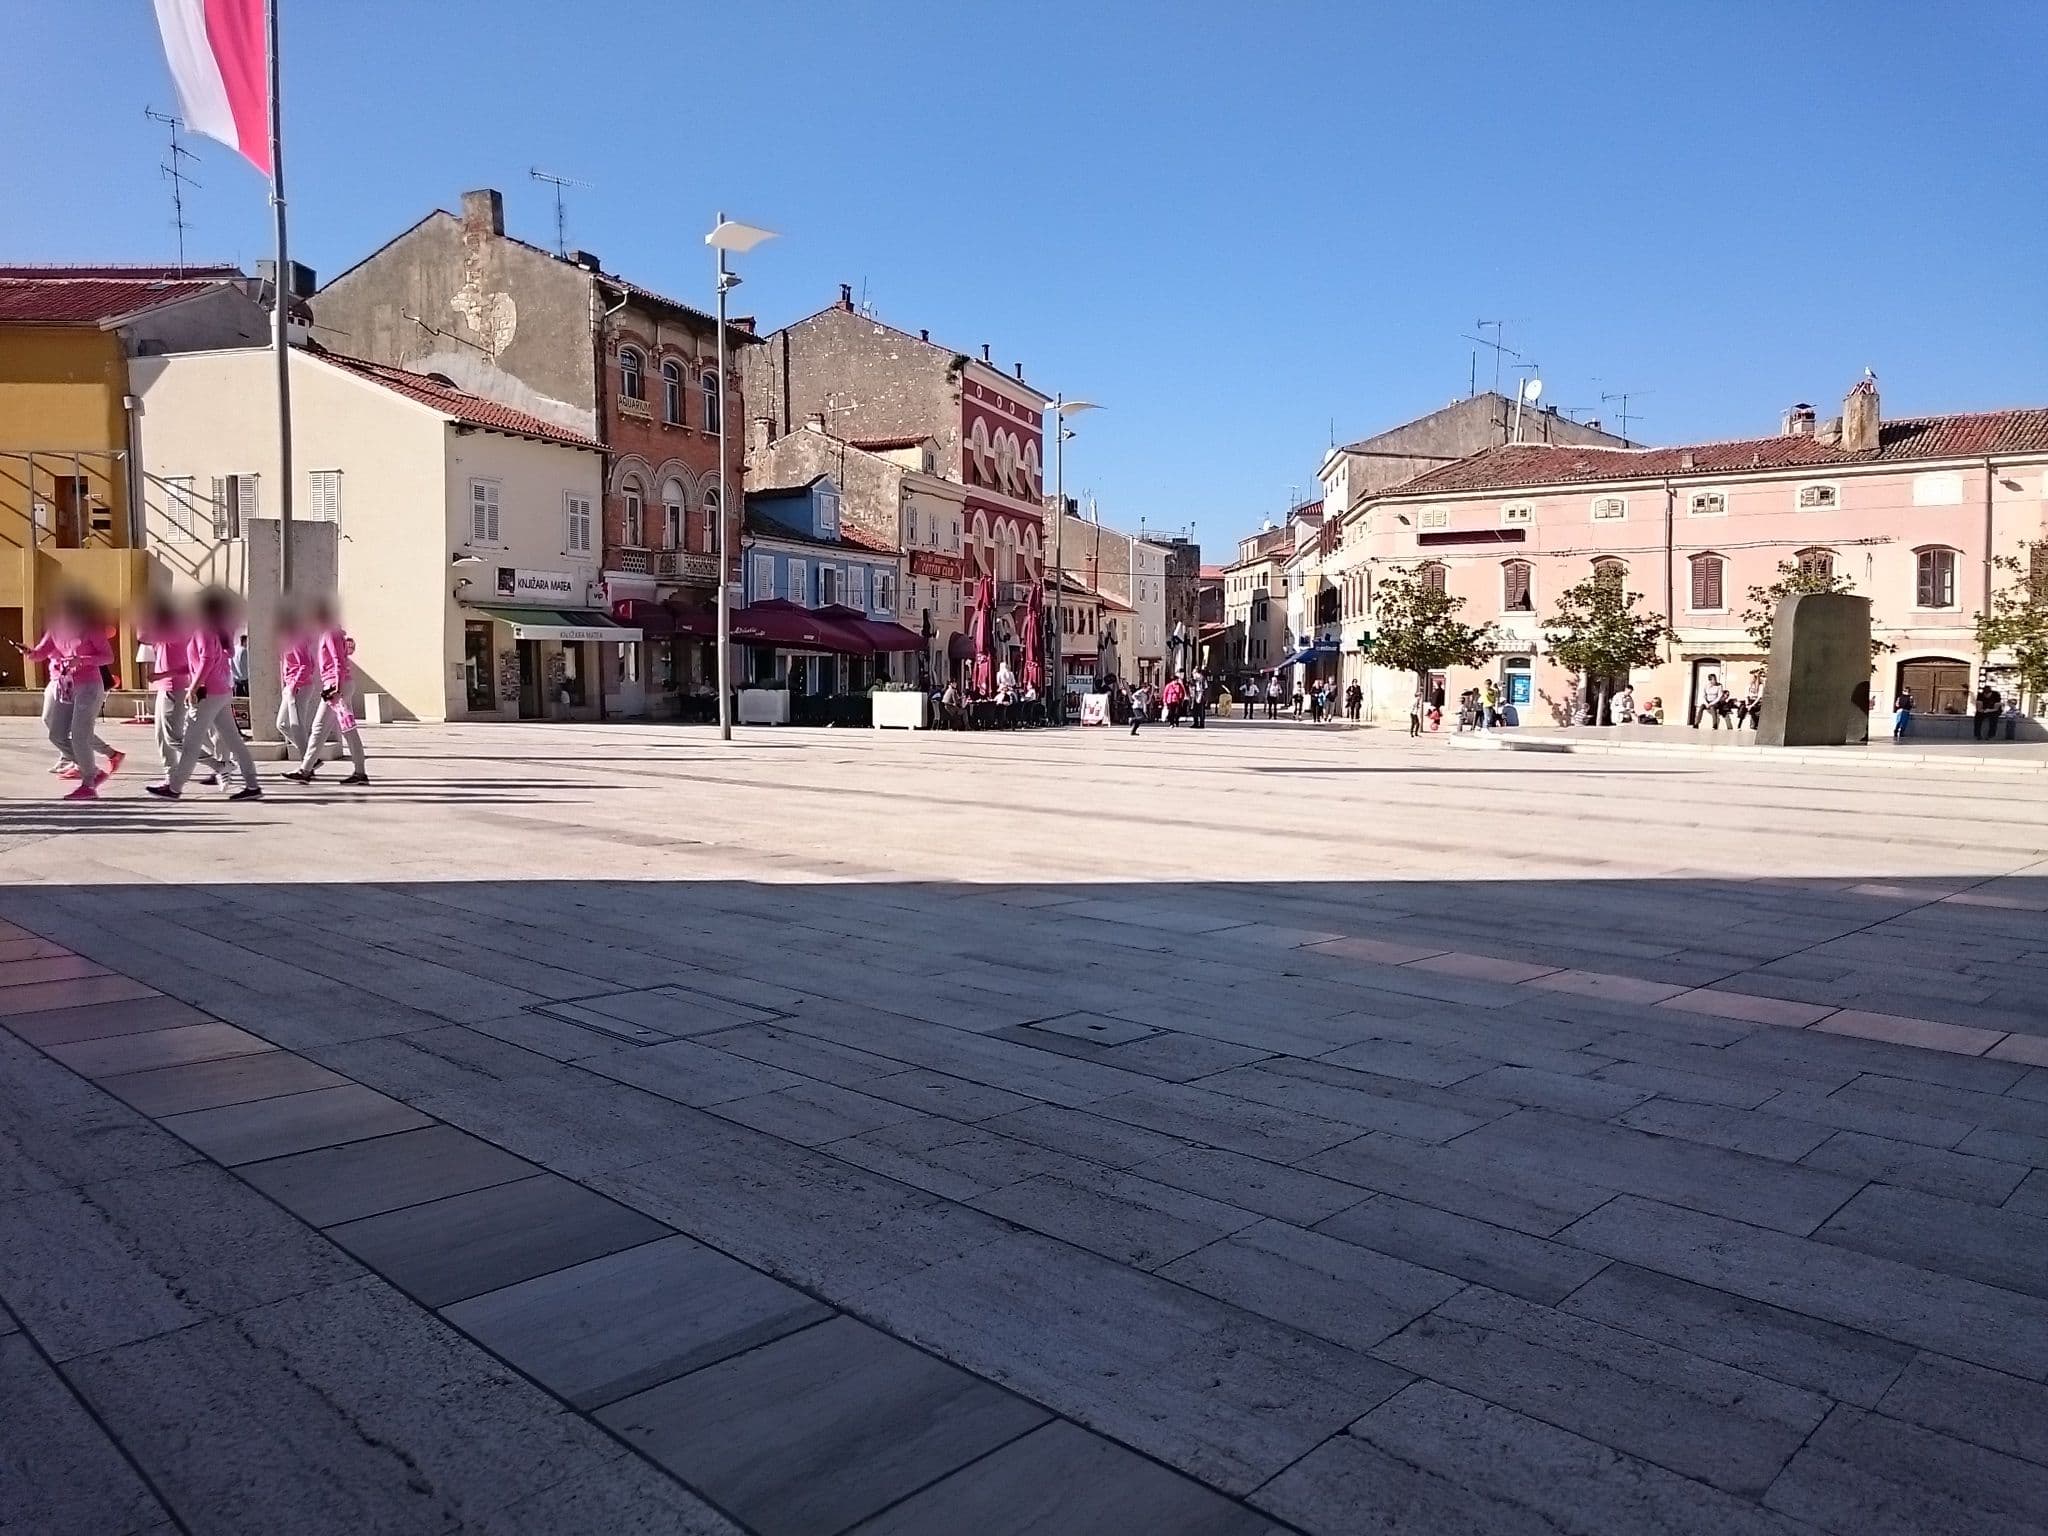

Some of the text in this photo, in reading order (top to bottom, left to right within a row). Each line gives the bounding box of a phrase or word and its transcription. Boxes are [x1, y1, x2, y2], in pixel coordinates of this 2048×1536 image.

[618, 396, 650, 412] AQUARIUM
[517, 577, 572, 592] KNJIŽARA MATEA
